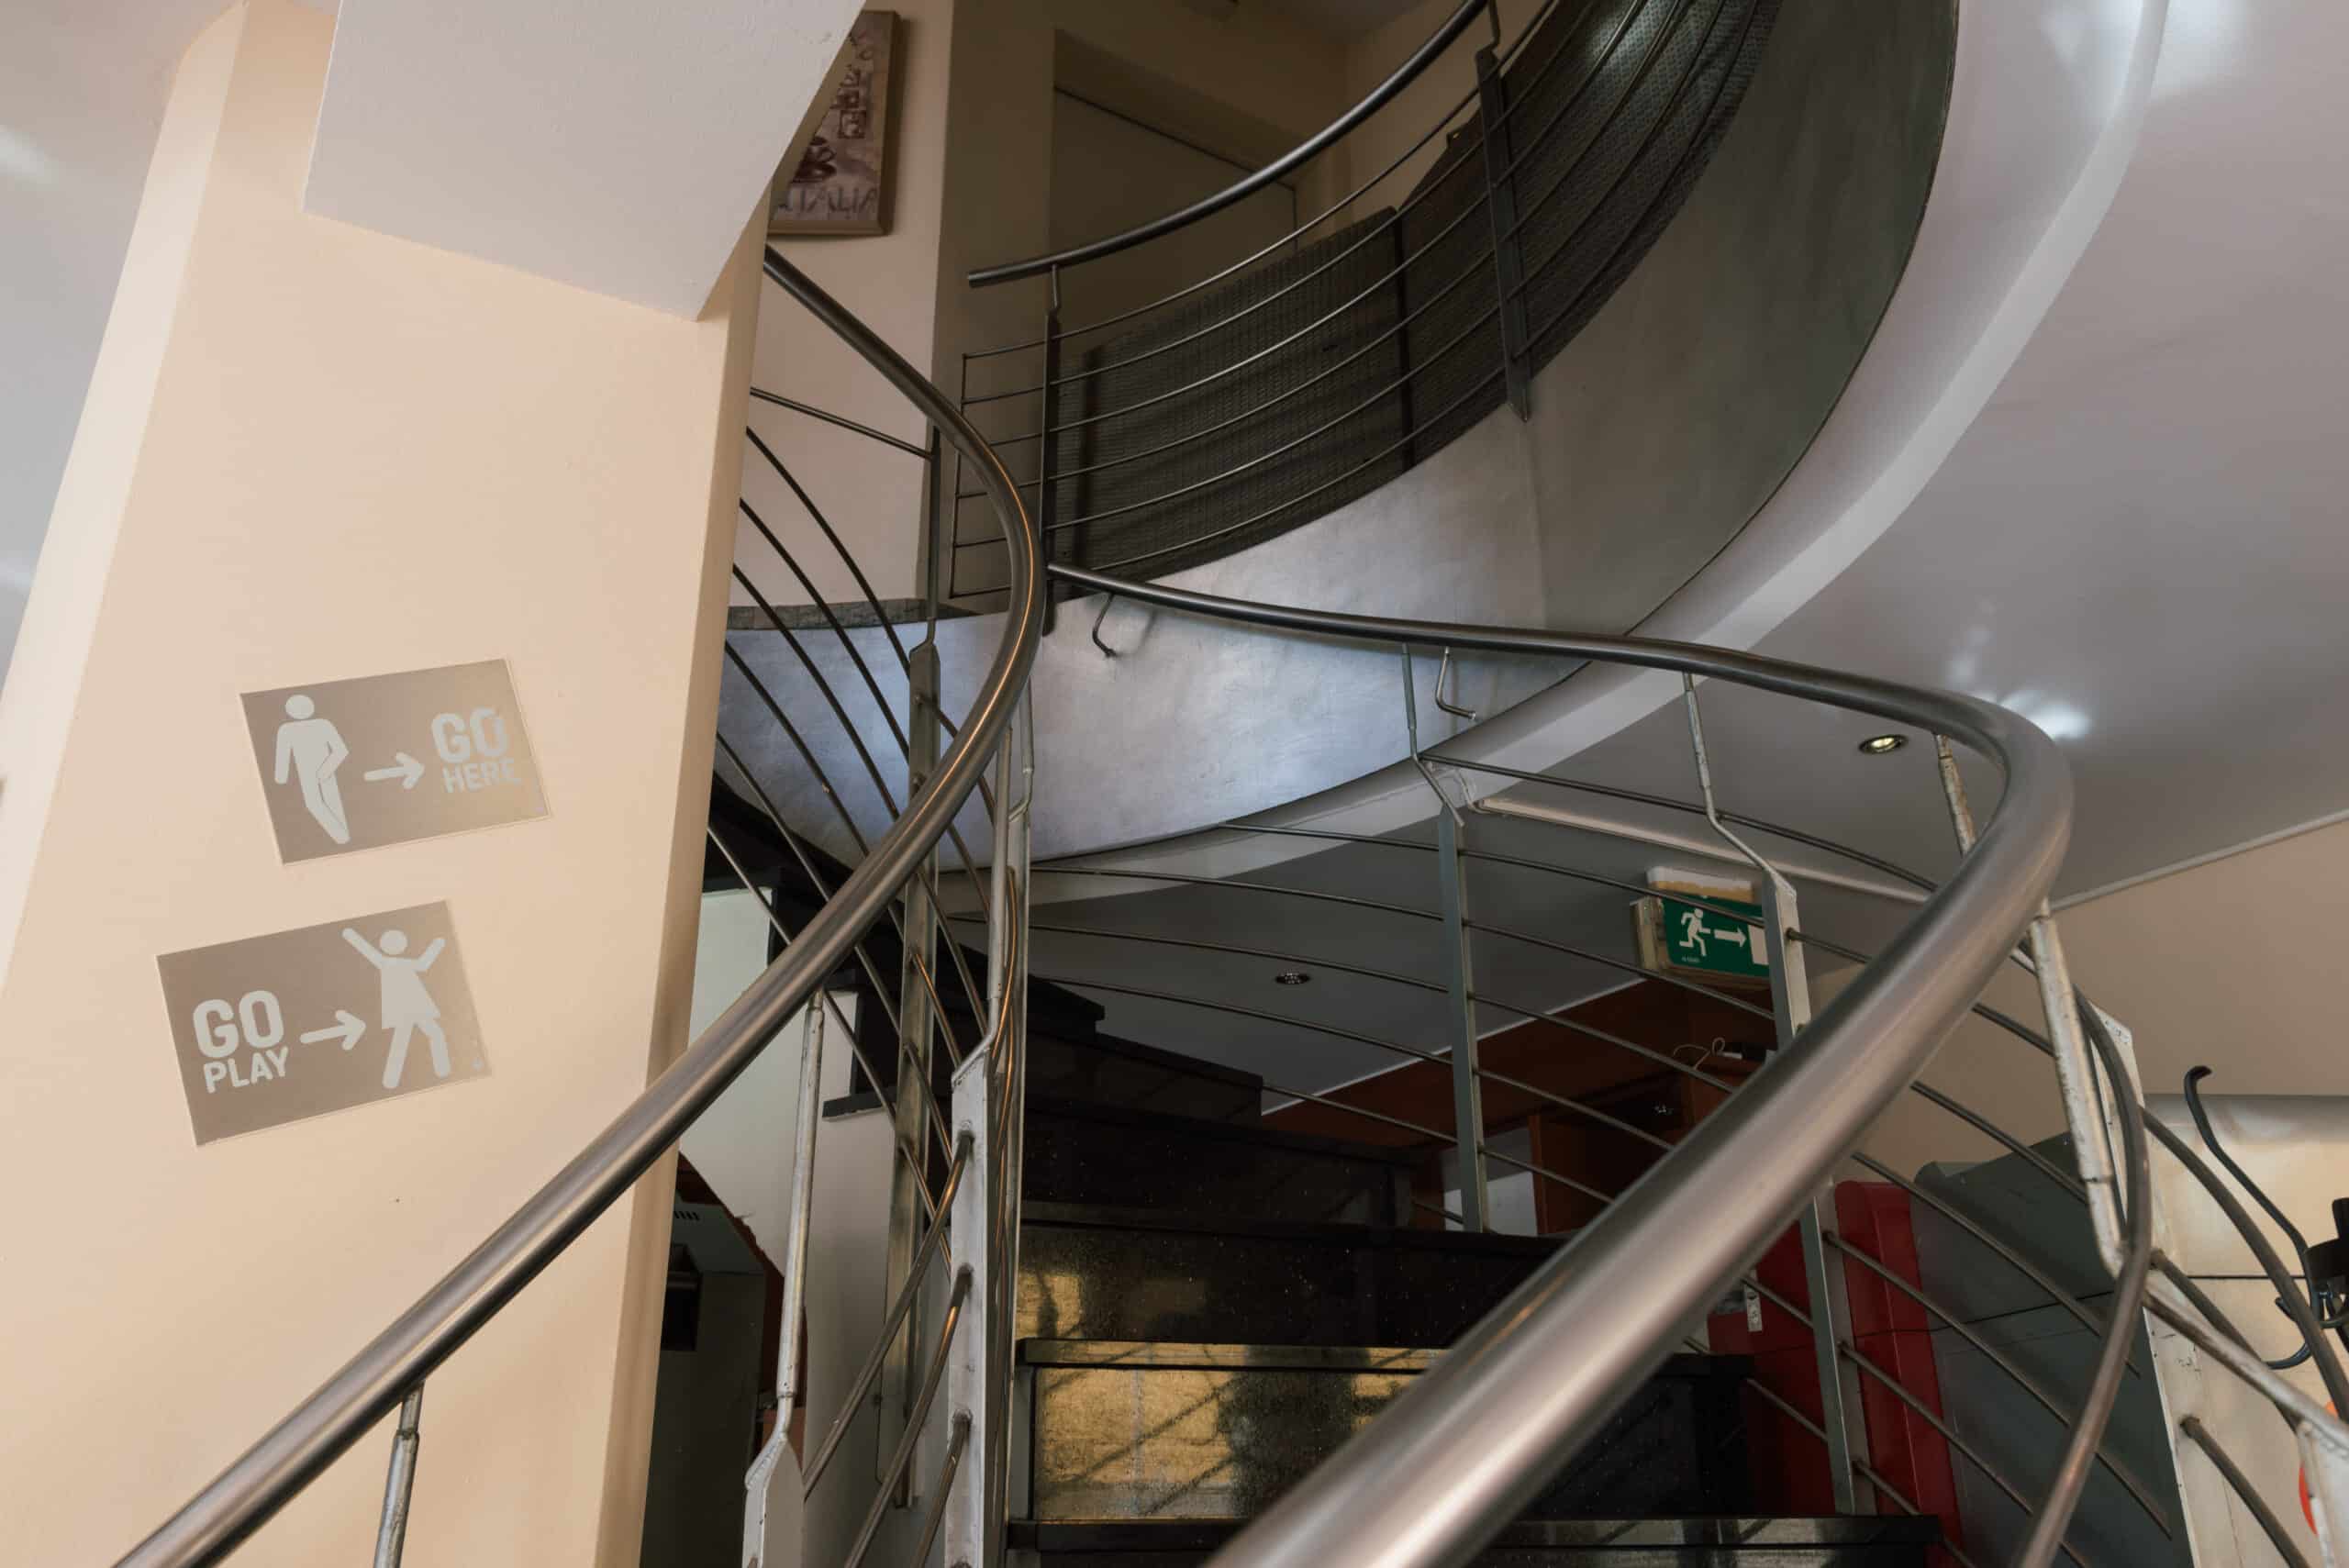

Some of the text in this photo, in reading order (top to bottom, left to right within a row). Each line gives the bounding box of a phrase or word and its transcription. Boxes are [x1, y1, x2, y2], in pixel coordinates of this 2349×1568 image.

[431, 707, 507, 762] GO
[442, 757, 521, 794] HERE
[193, 990, 284, 1058] GO
[203, 1046, 289, 1094] PLAY
